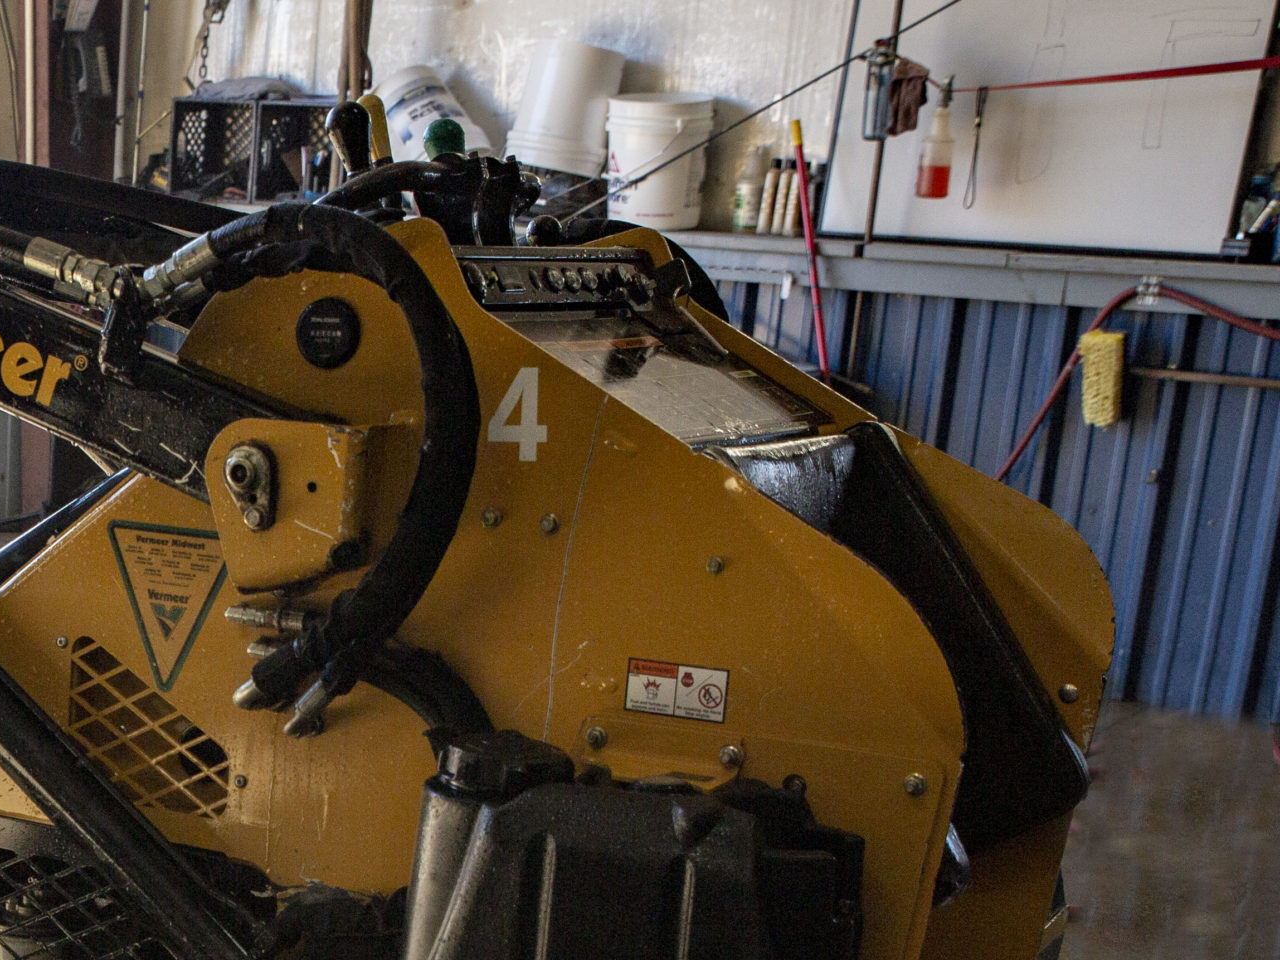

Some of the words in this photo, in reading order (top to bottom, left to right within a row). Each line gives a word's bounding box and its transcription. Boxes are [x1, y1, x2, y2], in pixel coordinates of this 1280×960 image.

[488, 368, 547, 461] 4
[136, 534, 169, 546] Vermeer
[171, 538, 206, 550] Midwest
[147, 588, 189, 604] Vermeer
